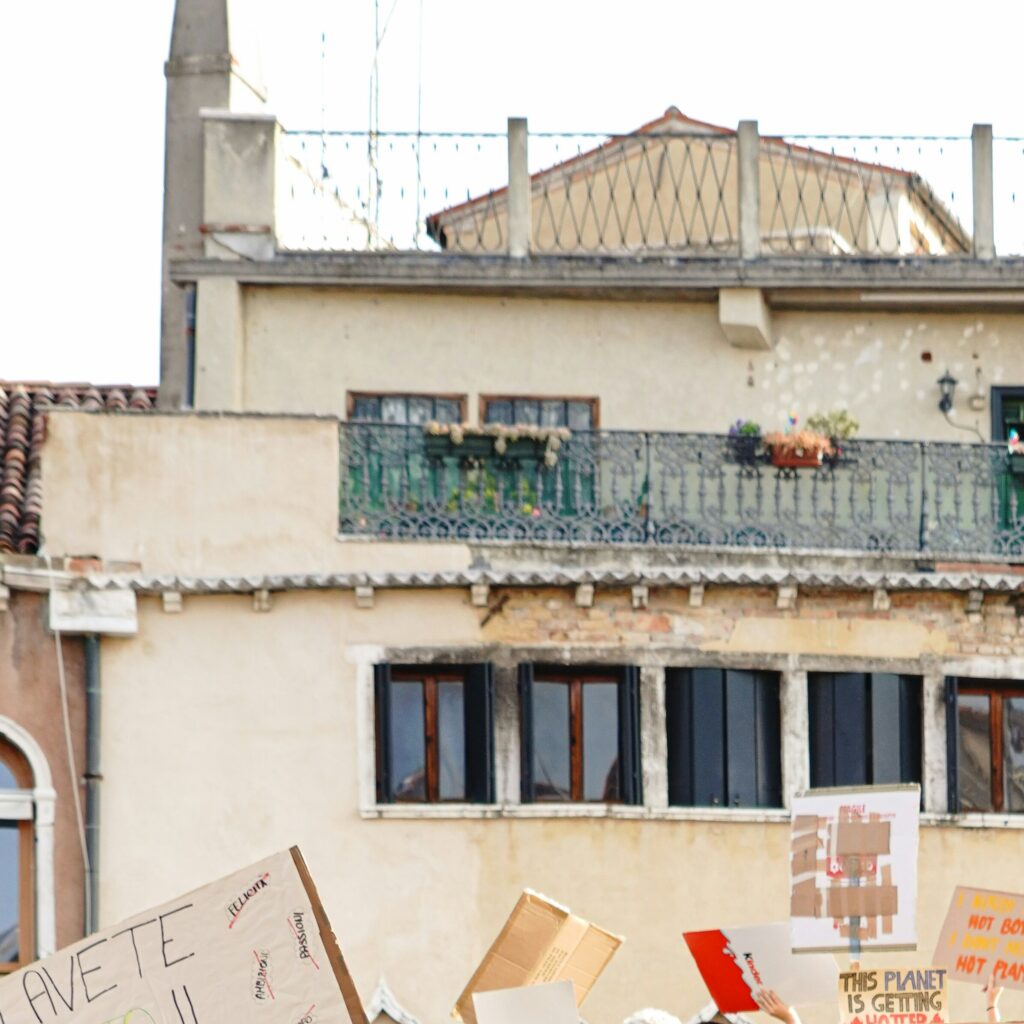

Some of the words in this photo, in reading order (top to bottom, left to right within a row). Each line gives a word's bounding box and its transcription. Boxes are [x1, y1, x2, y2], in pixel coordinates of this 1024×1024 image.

[968, 914, 995, 931] HOT
[292, 912, 310, 959] PASSIONI
[22, 903, 195, 1024] AVETE
[955, 954, 987, 975] HOT
[840, 971, 878, 992] THIS
[884, 969, 947, 992] PLANET
[847, 994, 866, 1014] IS
[871, 990, 943, 1013] GETTING
